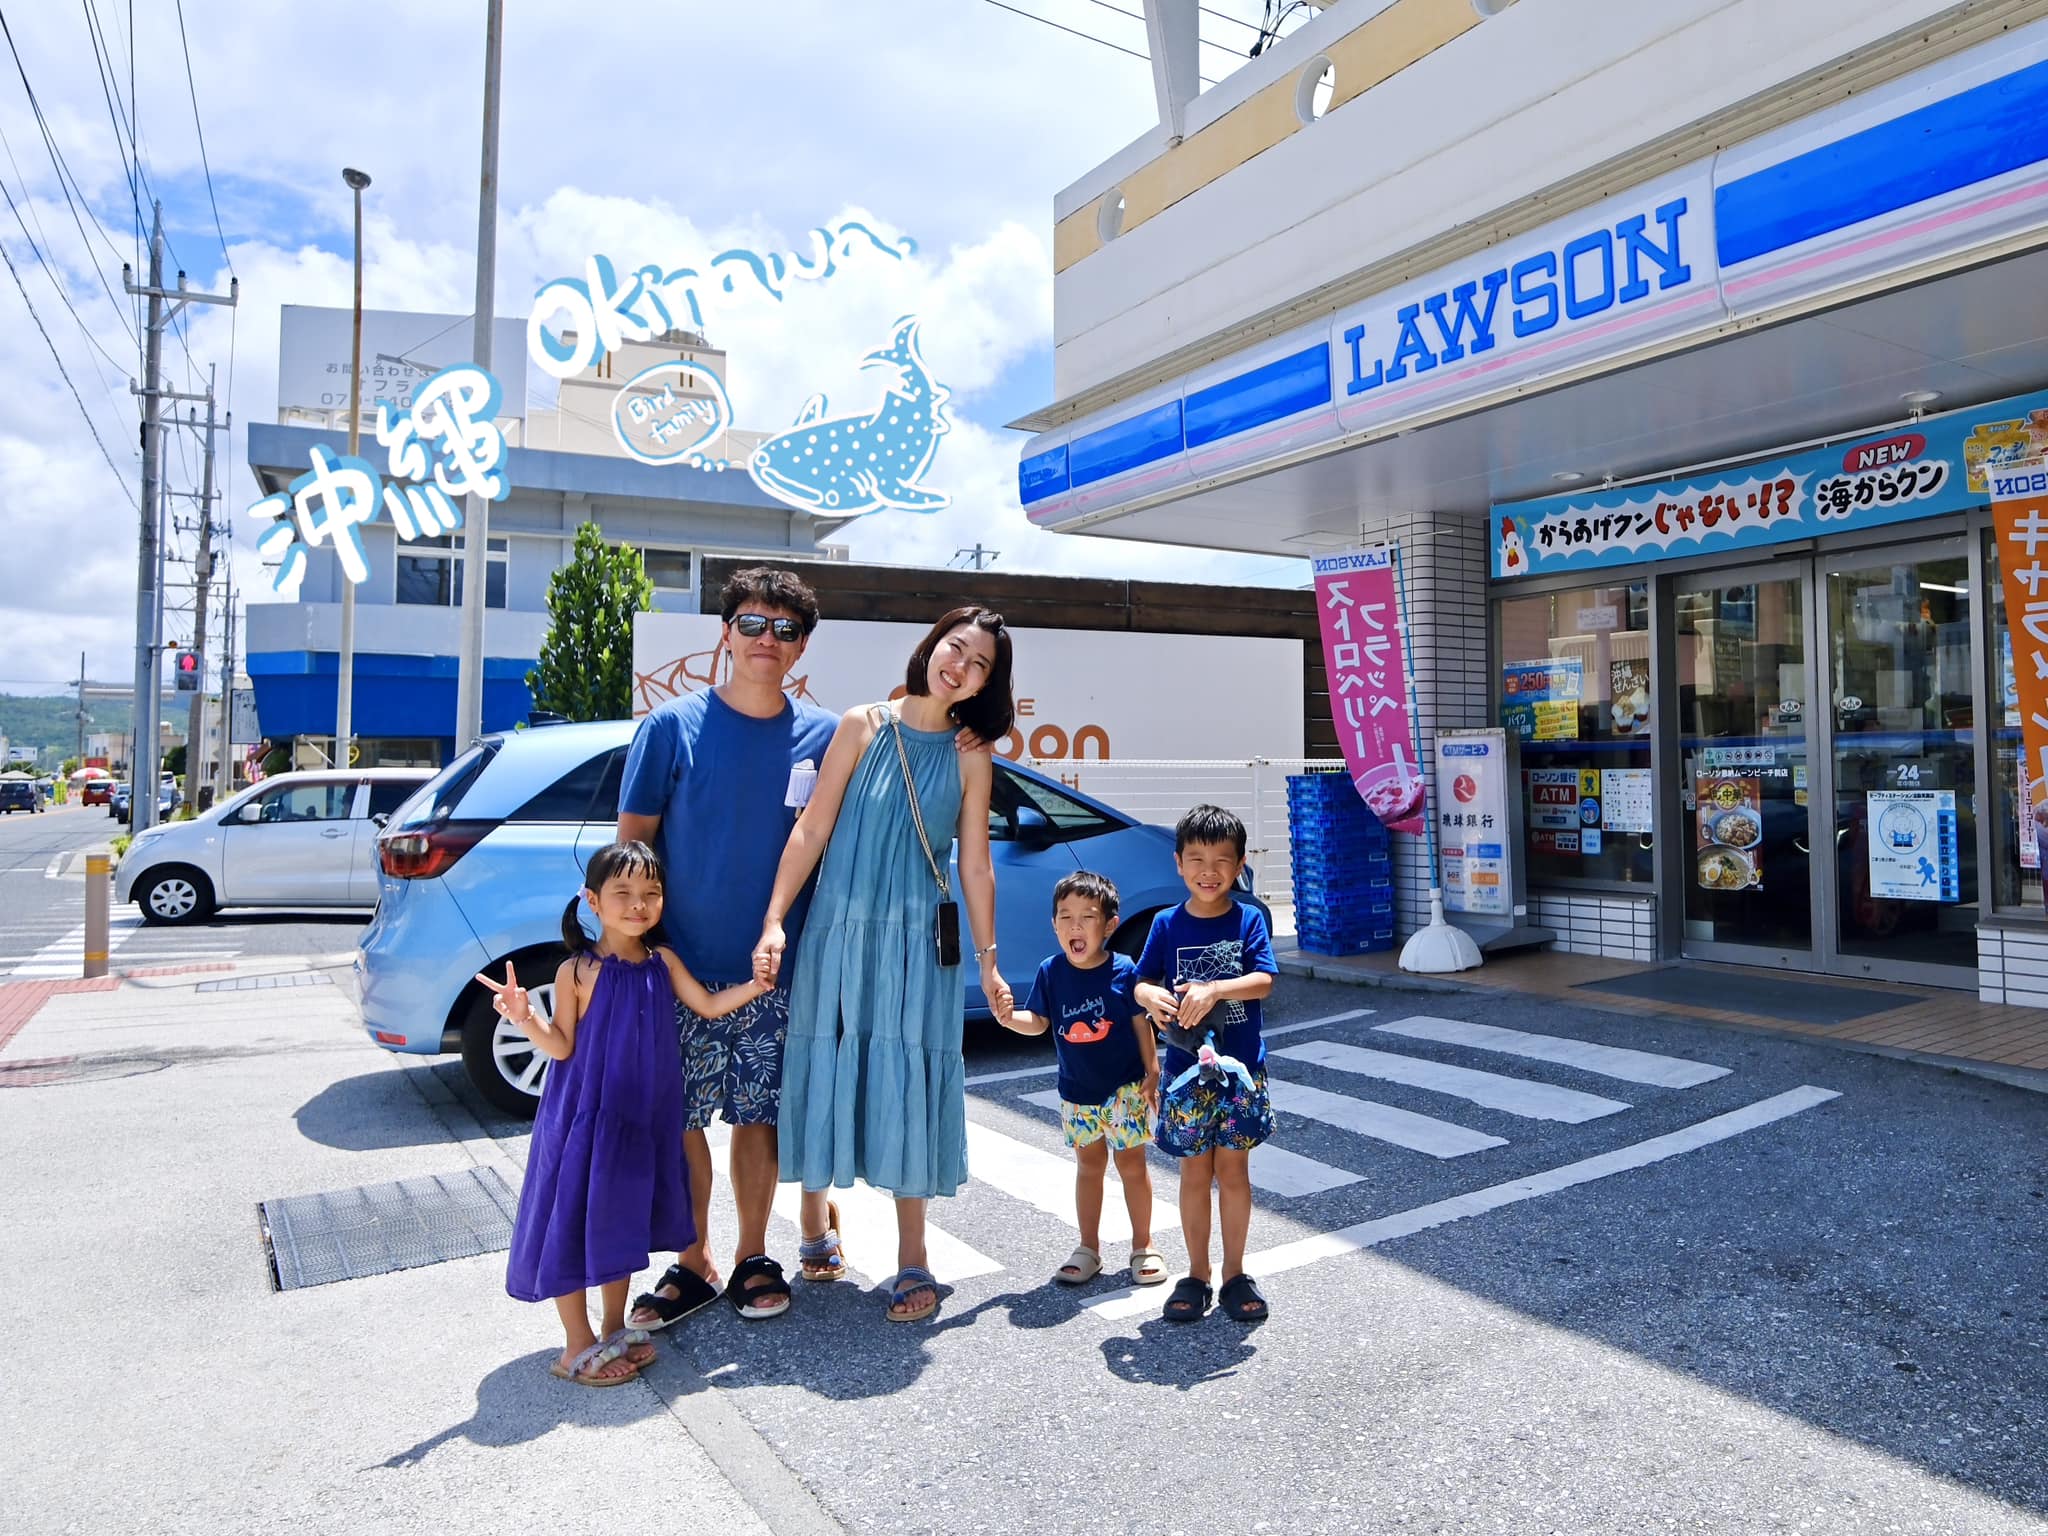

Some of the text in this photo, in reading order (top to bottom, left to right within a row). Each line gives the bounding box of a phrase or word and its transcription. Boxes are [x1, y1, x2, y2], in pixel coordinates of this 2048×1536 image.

[1344, 197, 1690, 397] LAWSON
[1858, 440, 1911, 469] NEW
[1817, 462, 1945, 516] 海からクン
[1897, 763, 1920, 780] 24
[1540, 788, 1570, 801] ATM
[1062, 995, 1104, 1019] Lucky
